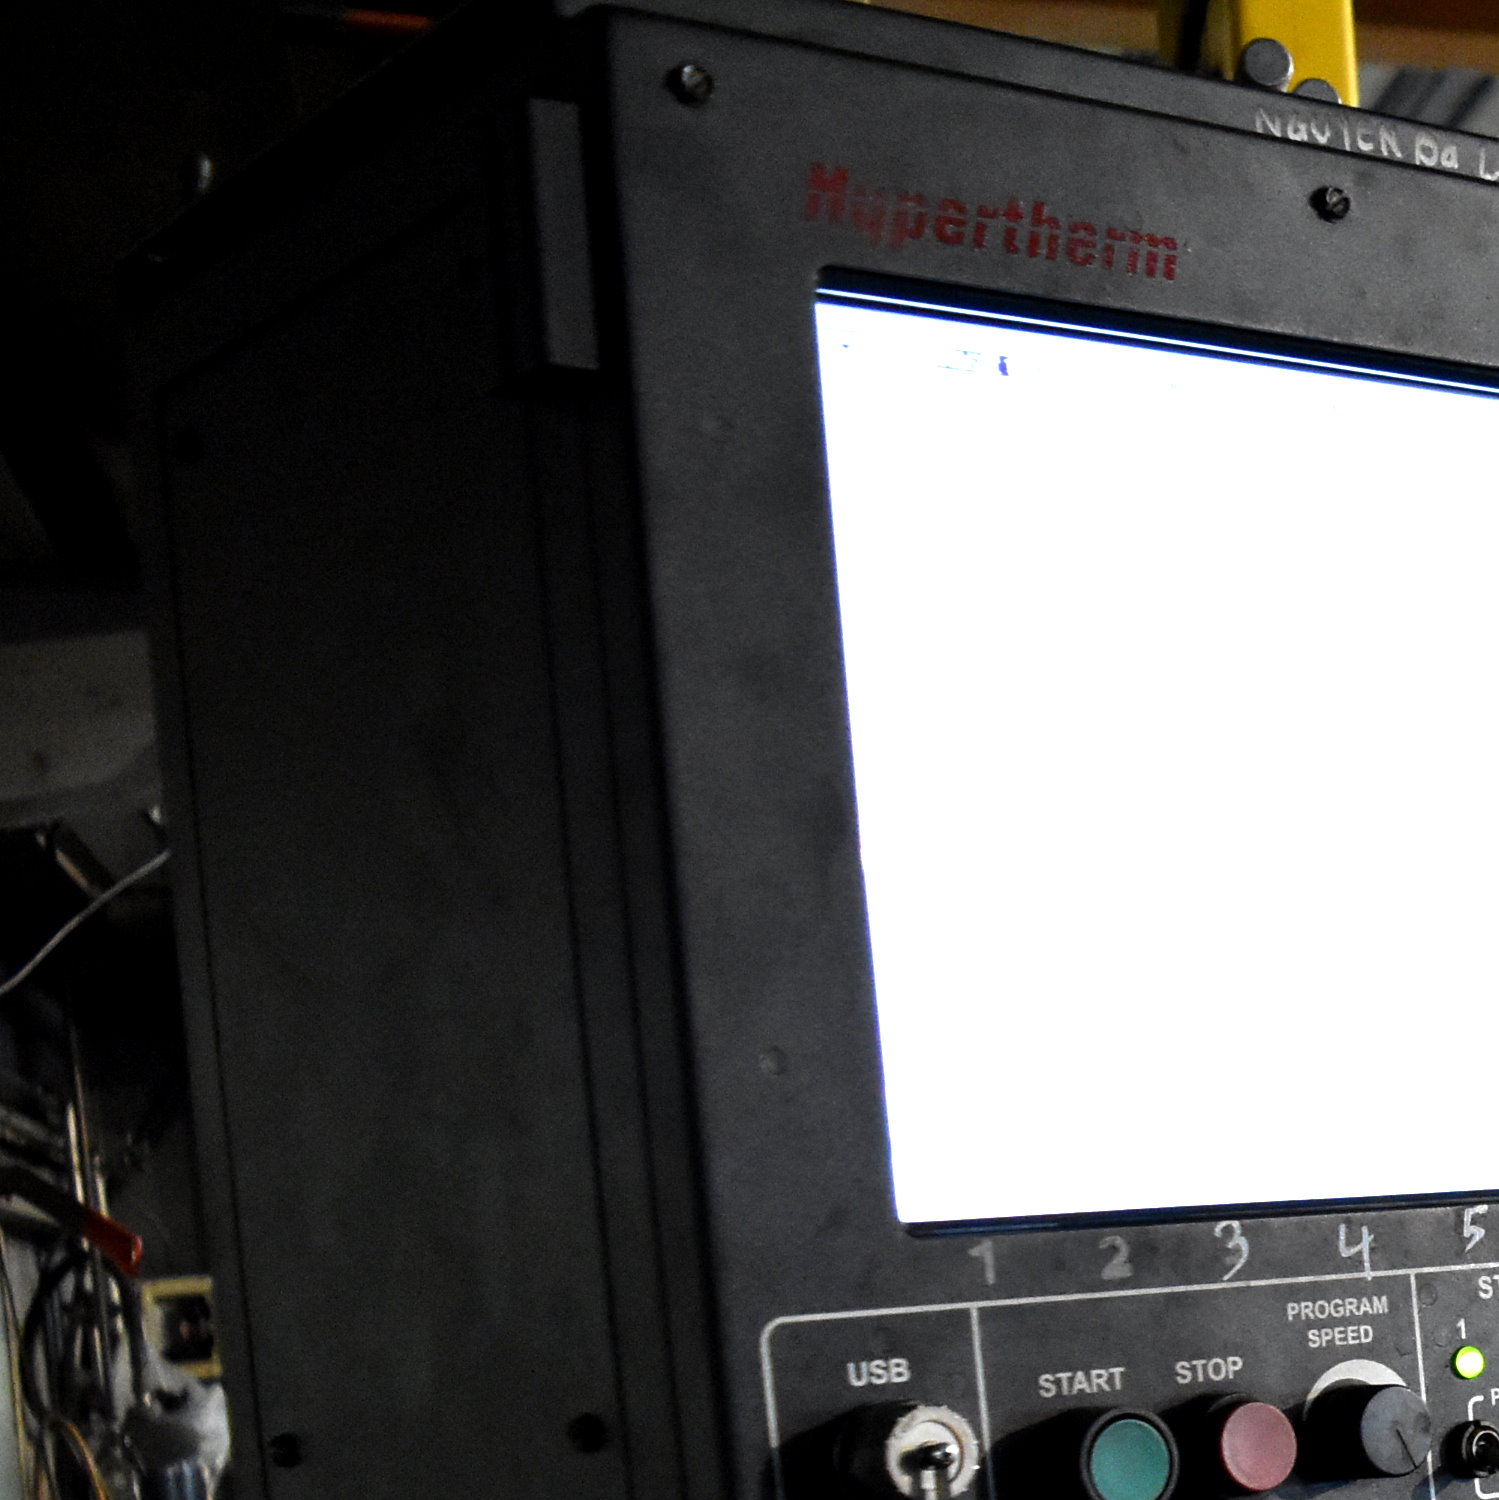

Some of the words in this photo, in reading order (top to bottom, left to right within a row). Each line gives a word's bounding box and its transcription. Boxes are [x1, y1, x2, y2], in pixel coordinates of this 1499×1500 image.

[804, 160, 1178, 281] Hypertherm
[967, 1239, 997, 1285] 1
[1099, 1235, 1134, 1281] 2
[1213, 1220, 1250, 1281] 3
[1338, 1224, 1375, 1281] 4
[1461, 1204, 1490, 1253] 5
[1286, 1295, 1390, 1322] PROGRAM
[1307, 1325, 1374, 1349] SPEED
[1456, 1319, 1467, 1340] 1
[846, 1357, 912, 1388] USB
[1037, 1366, 1127, 1398] START
[1174, 1355, 1244, 1386] STOP
